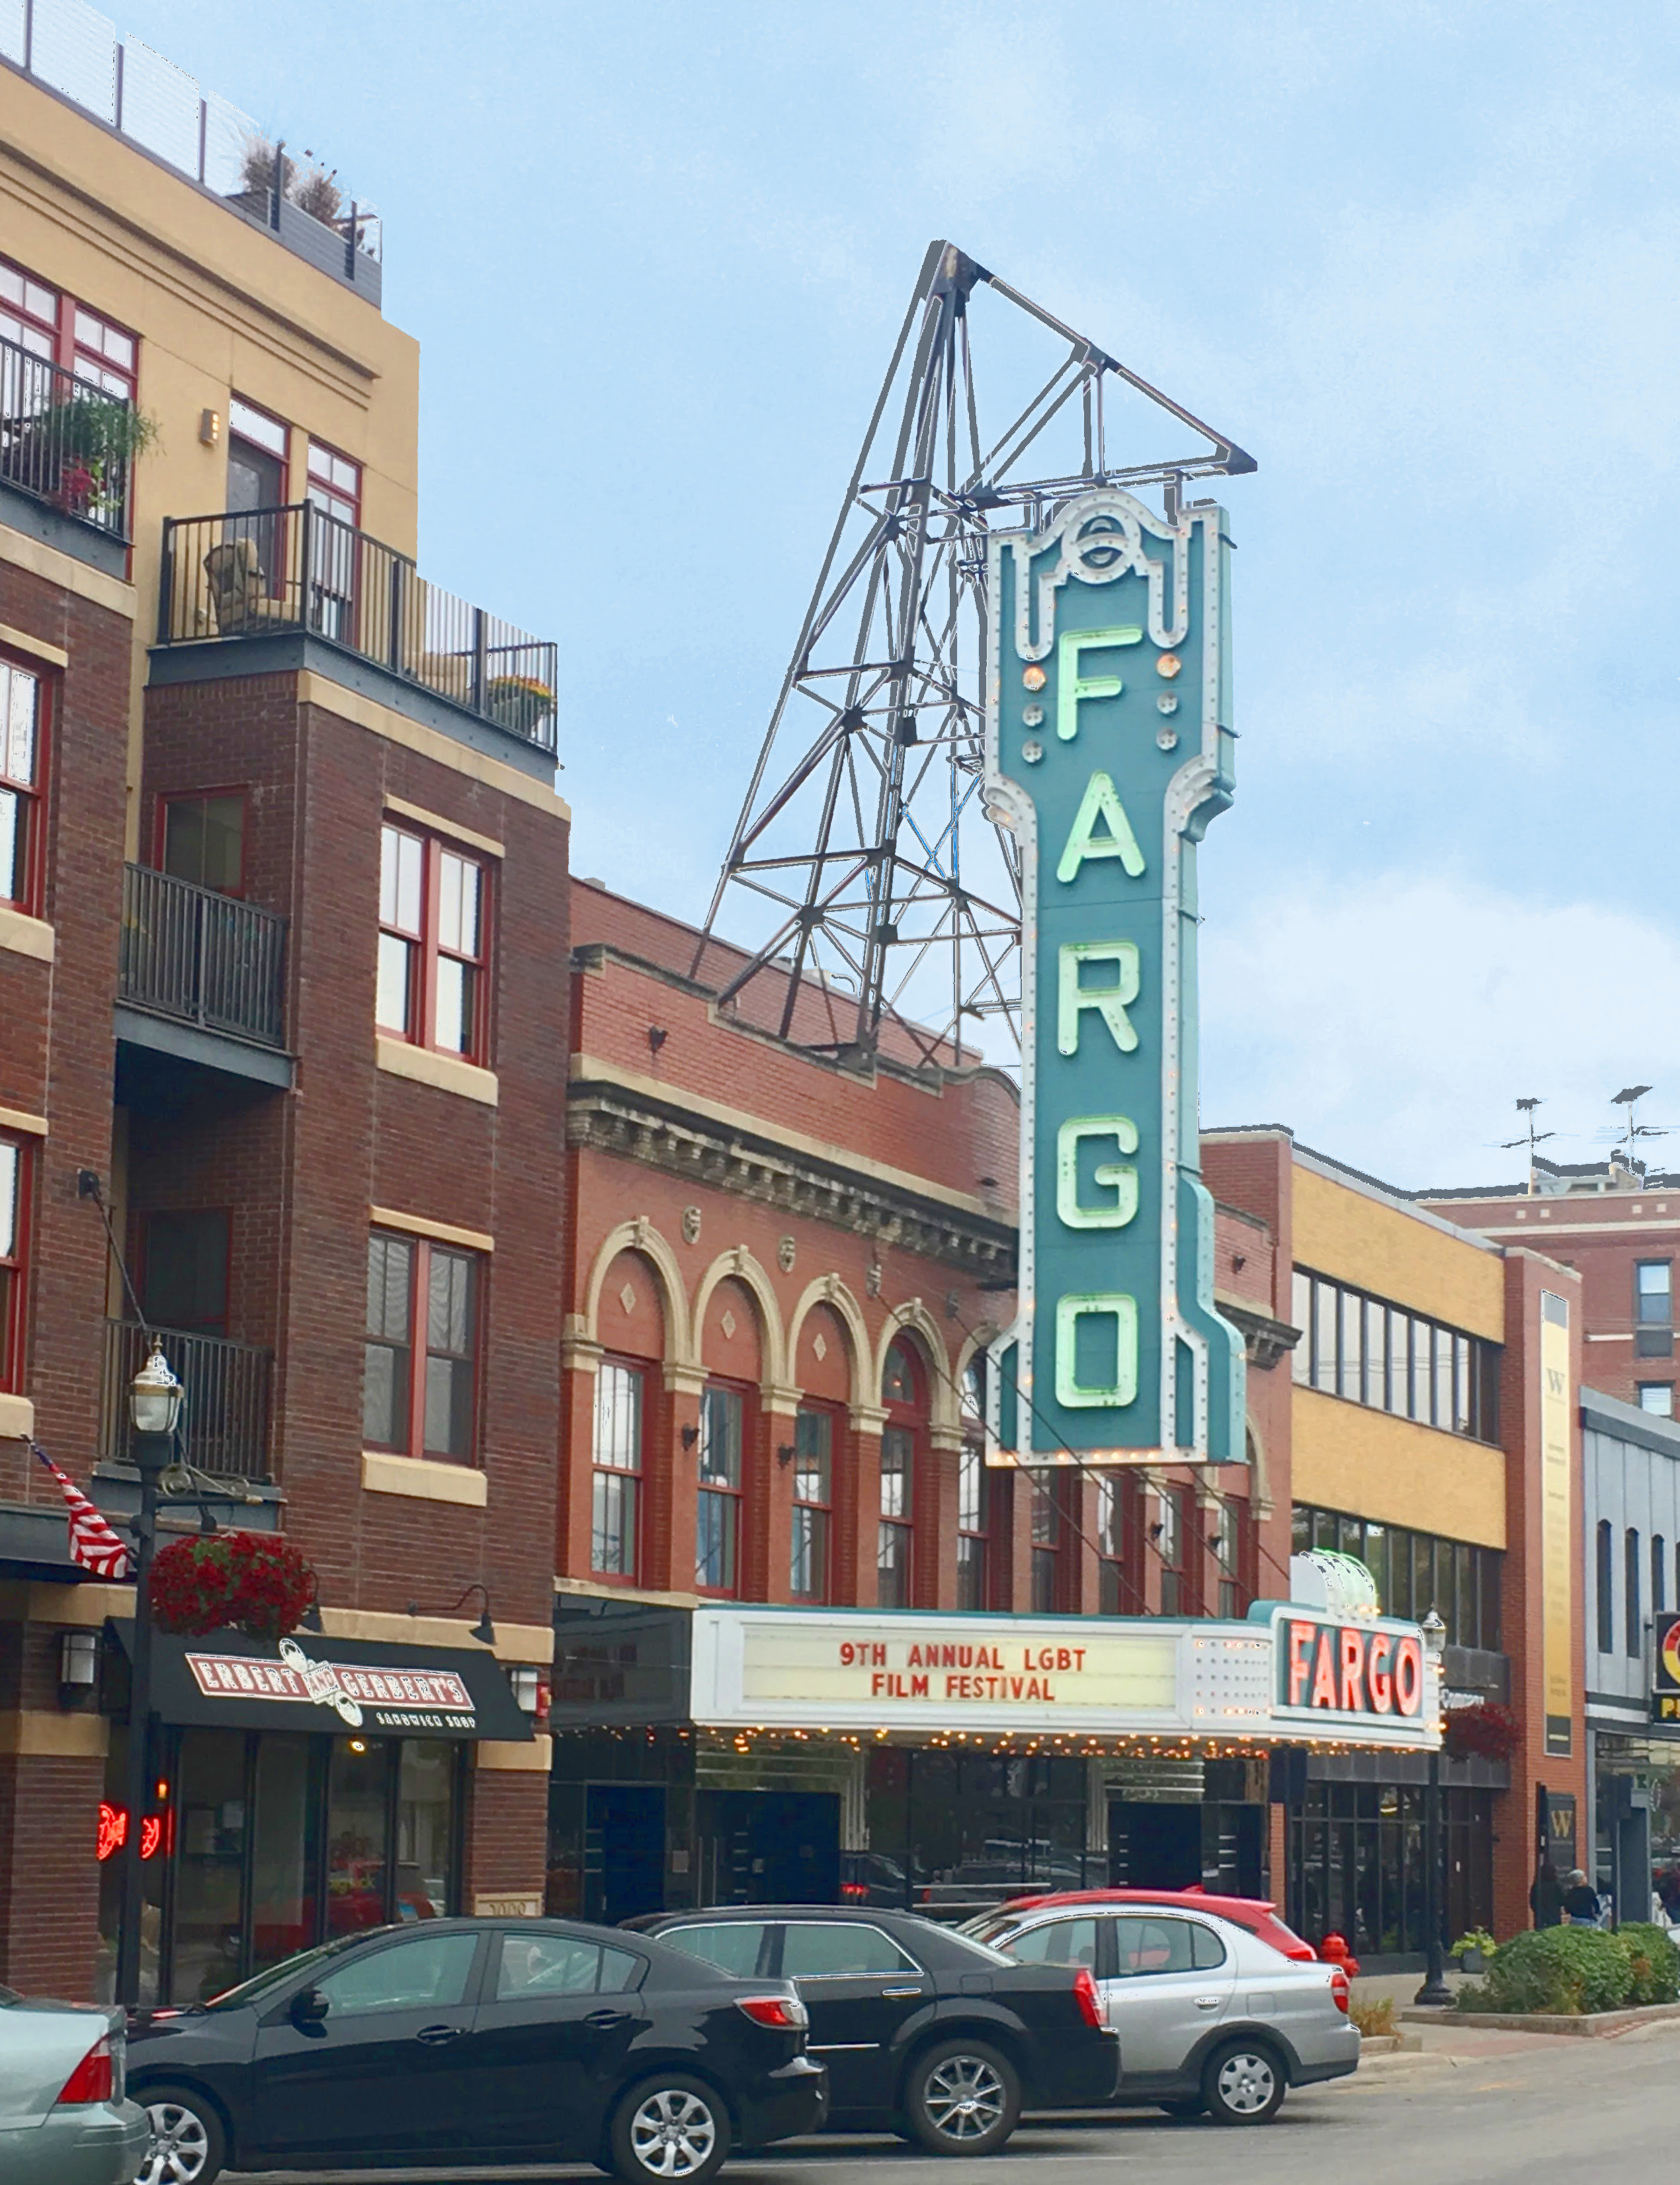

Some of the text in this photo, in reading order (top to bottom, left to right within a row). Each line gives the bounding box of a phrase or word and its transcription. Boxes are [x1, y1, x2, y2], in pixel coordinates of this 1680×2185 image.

[1055, 624, 1145, 1407] FARGO
[839, 1642, 1086, 1672] 9TH ANNUAL LGBT
[1289, 1620, 1421, 1716] FARGO
[198, 1661, 464, 1703] ERBERT AND GERBERT'S
[871, 1673, 1055, 1701] FILM FESTIVAL
[1550, 1809, 1573, 1838] W
